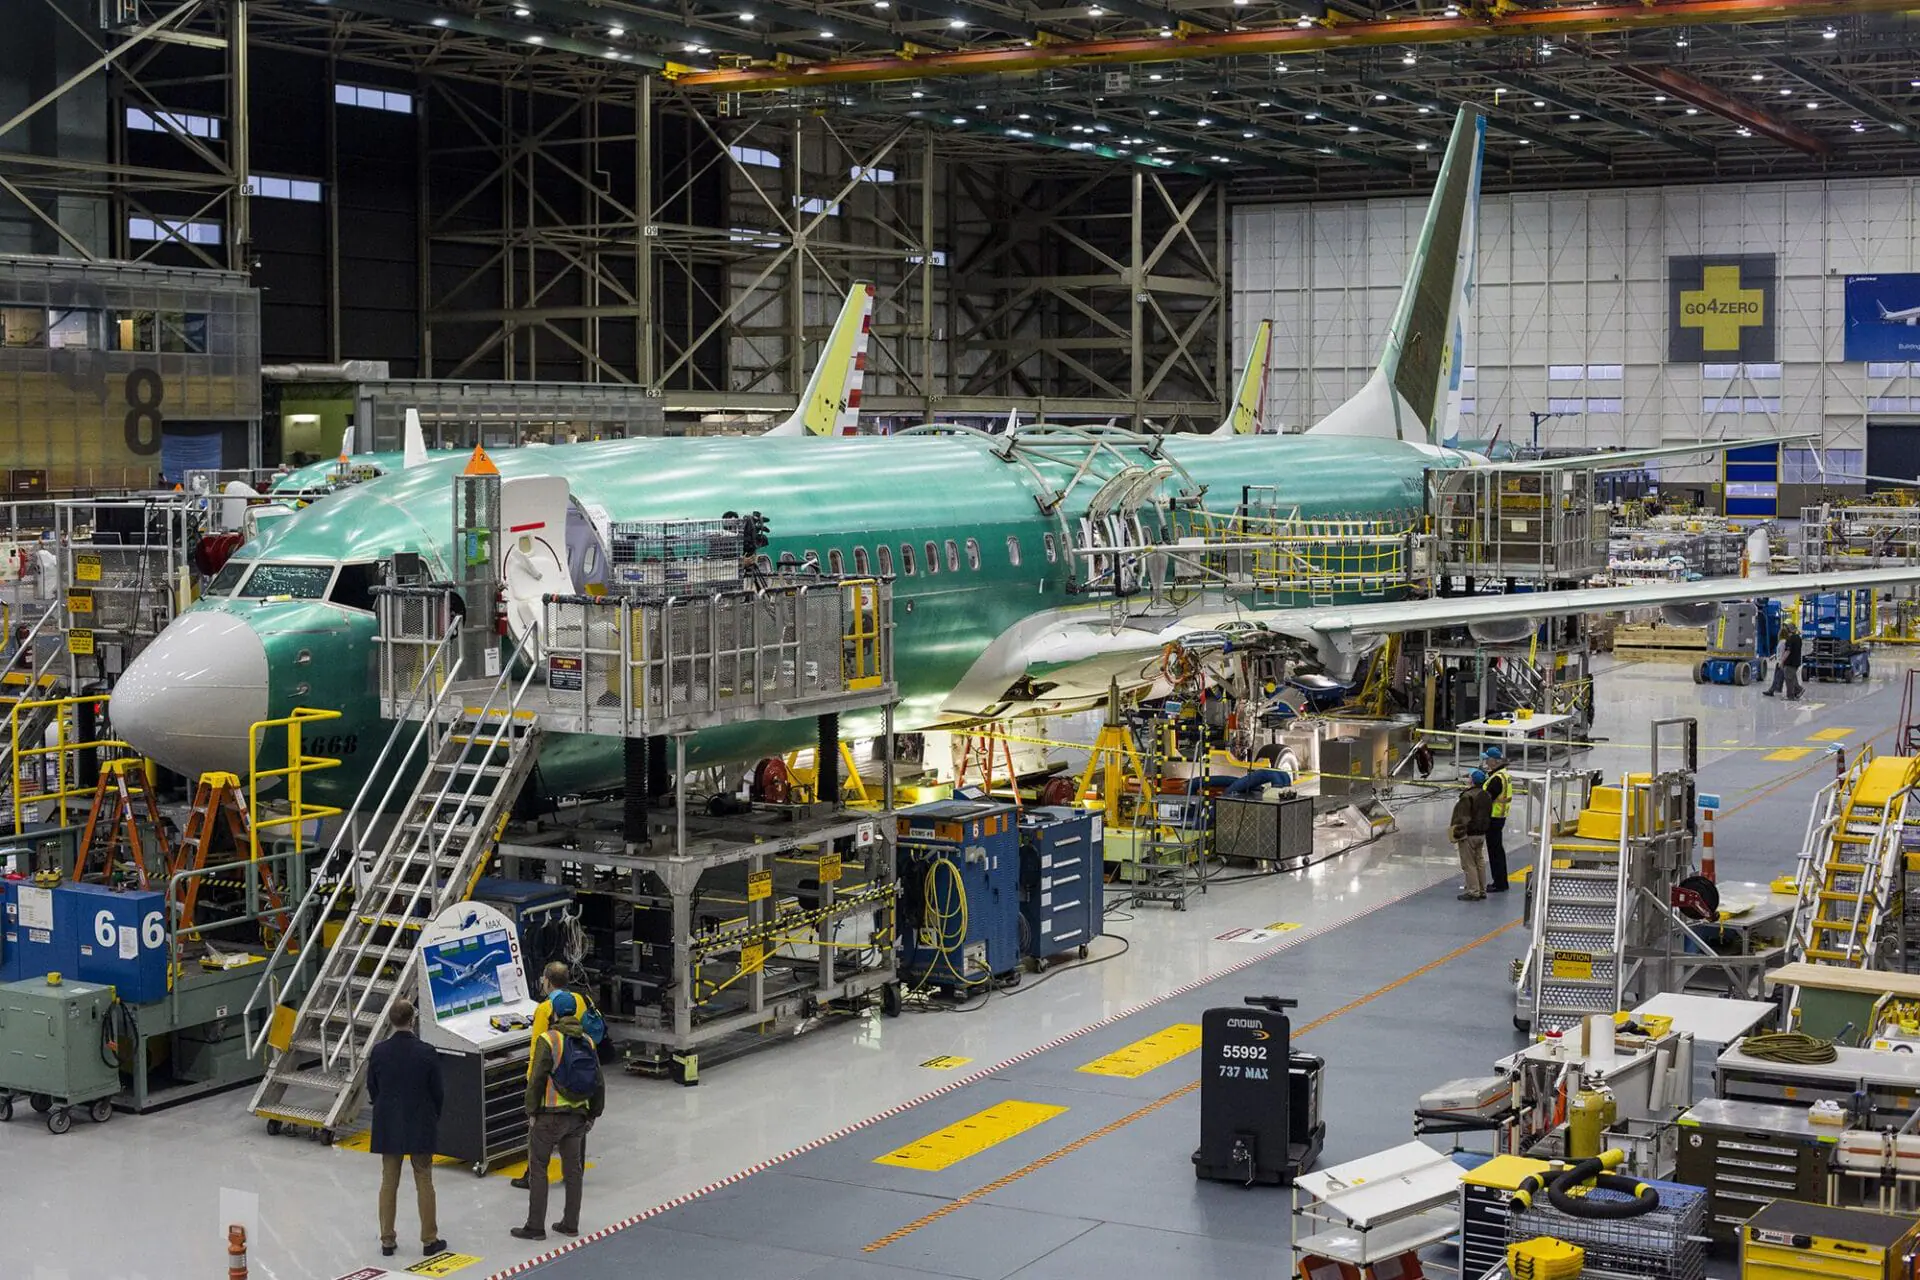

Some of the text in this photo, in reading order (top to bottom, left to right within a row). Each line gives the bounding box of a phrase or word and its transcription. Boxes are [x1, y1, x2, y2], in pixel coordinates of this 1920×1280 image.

[1685, 298, 1759, 315] GO4ZERO
[124, 368, 164, 456] 8
[94, 909, 116, 947] 6
[142, 910, 165, 949] 6
[1556, 952, 1590, 962] CAUTION
[1222, 1045, 1267, 1060] 55992
[1219, 1065, 1269, 1080] 737 MAX
